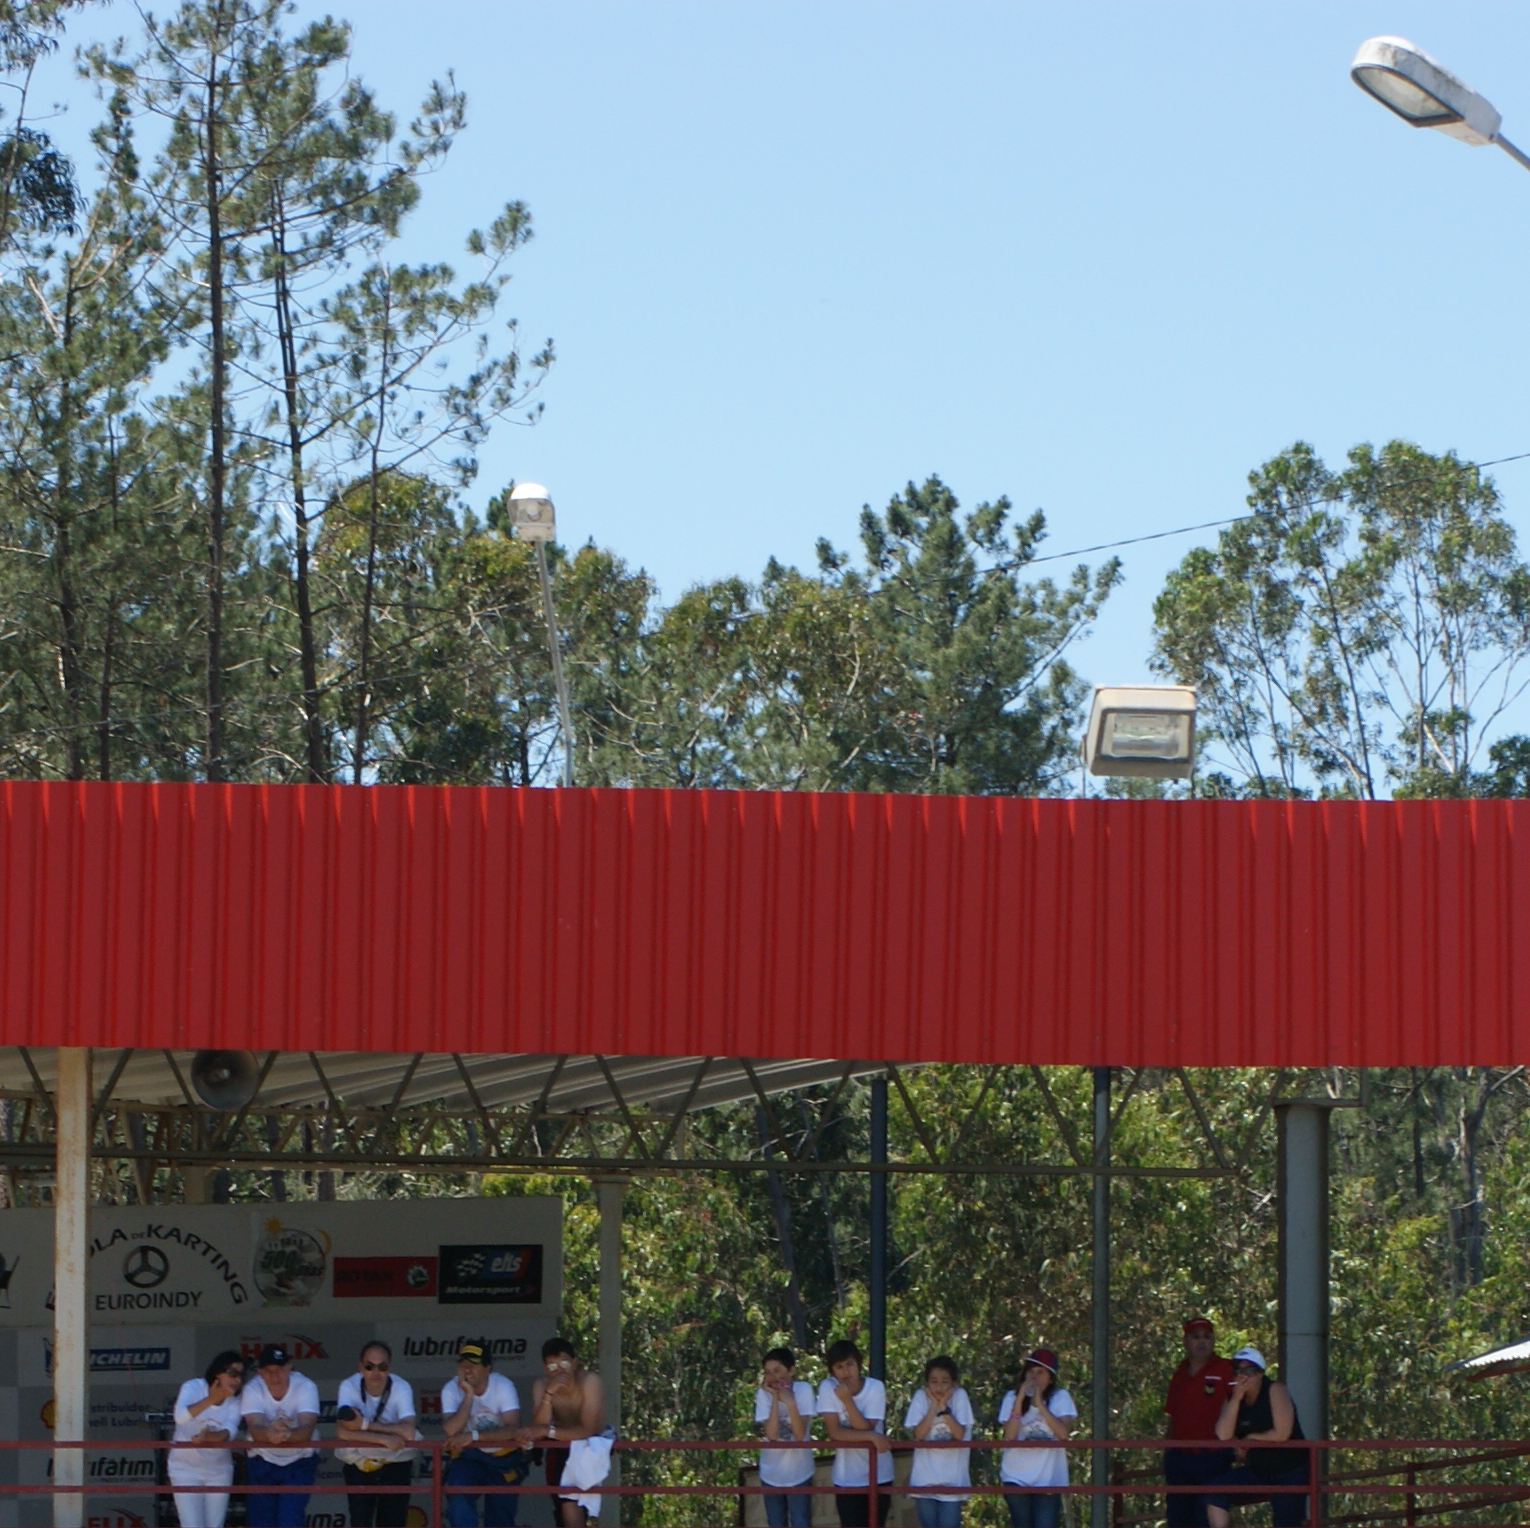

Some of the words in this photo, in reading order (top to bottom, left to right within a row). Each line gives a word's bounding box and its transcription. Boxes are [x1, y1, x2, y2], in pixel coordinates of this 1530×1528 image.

[146, 1223, 249, 1304] KARTING
[95, 1291, 203, 1311] EUROINDY
[90, 1352, 167, 1364] ICHELIN
